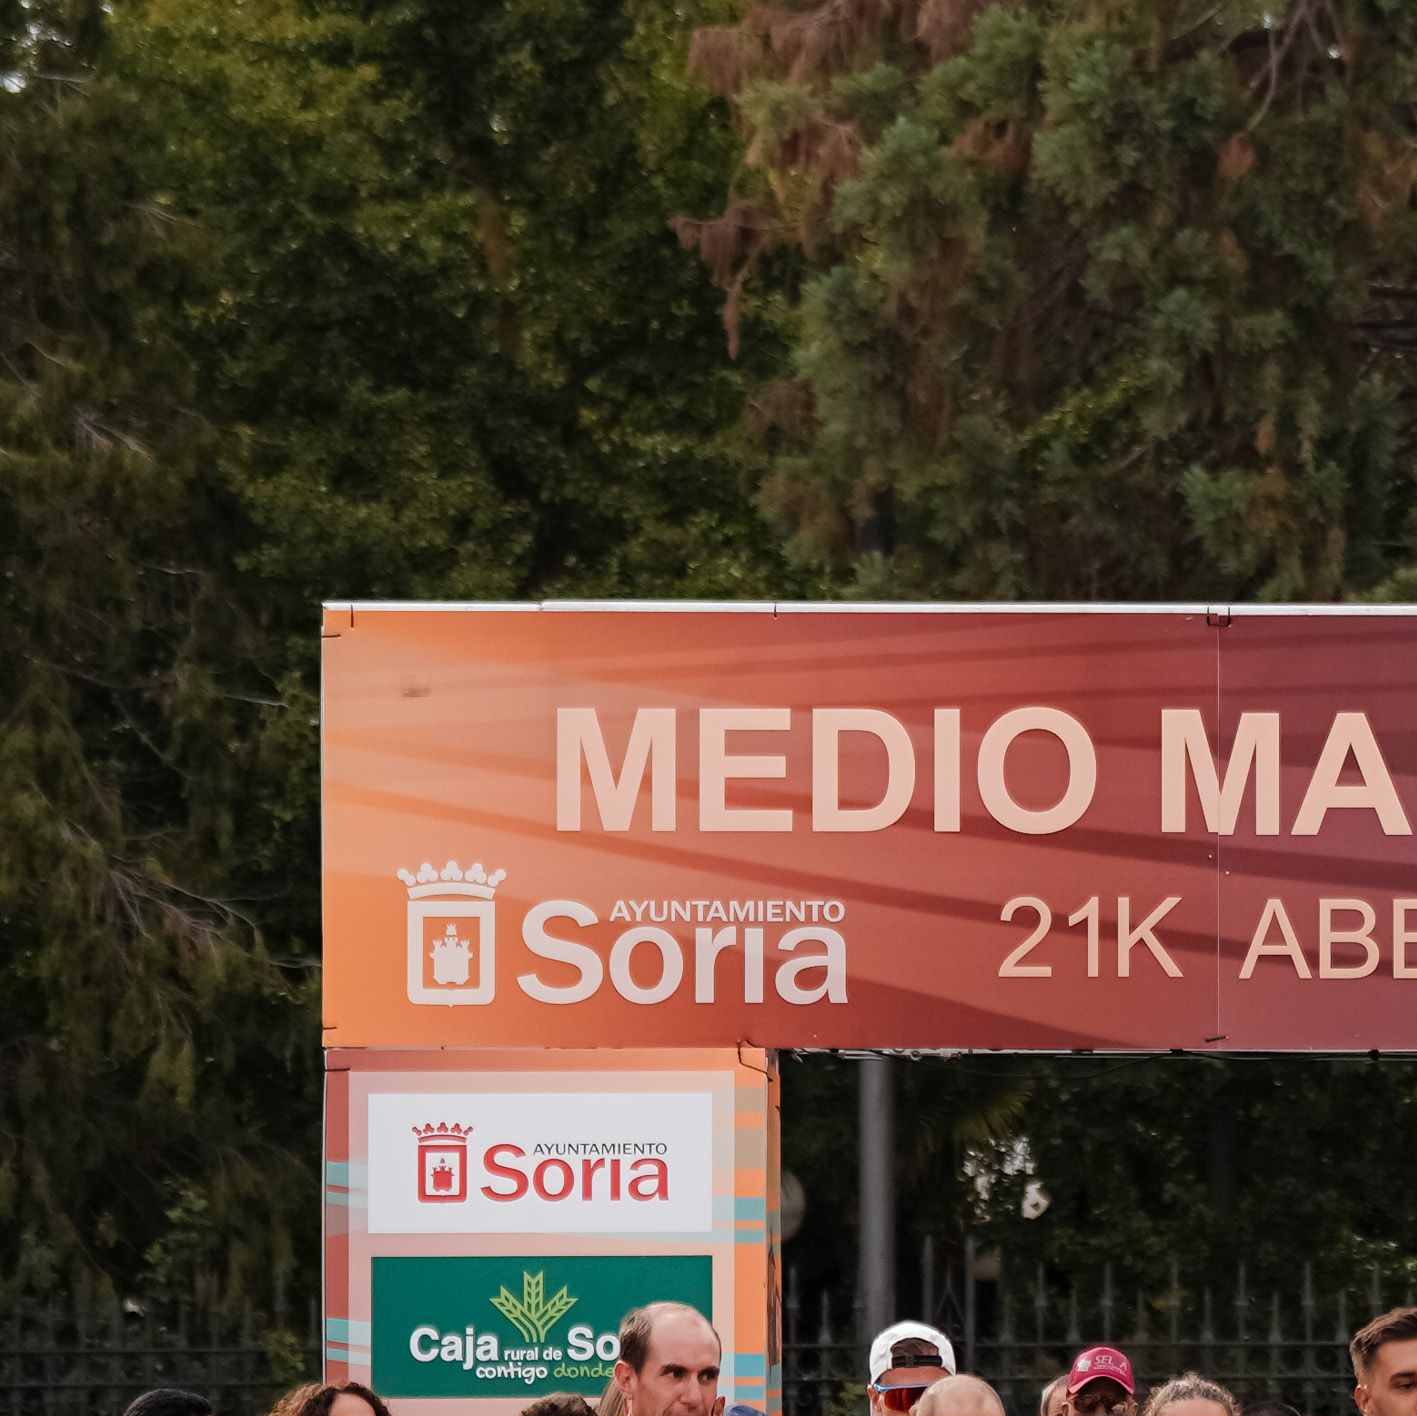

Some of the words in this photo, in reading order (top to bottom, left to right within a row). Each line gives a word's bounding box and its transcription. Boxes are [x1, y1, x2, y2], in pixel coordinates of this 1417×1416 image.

[556, 706, 1097, 835] MEDIO
[609, 899, 846, 923] AYUNTAMIENTO
[516, 899, 848, 1005] Soria
[998, 896, 1184, 978] 21K
[480, 1143, 670, 1202] Soria
[533, 1142, 668, 1156] AYUNTAMIENTO
[409, 1326, 499, 1370] Caja
[504, 1346, 539, 1361] rural
[542, 1347, 562, 1361] de
[566, 1326, 621, 1362] So
[475, 1361, 547, 1384] contigo
